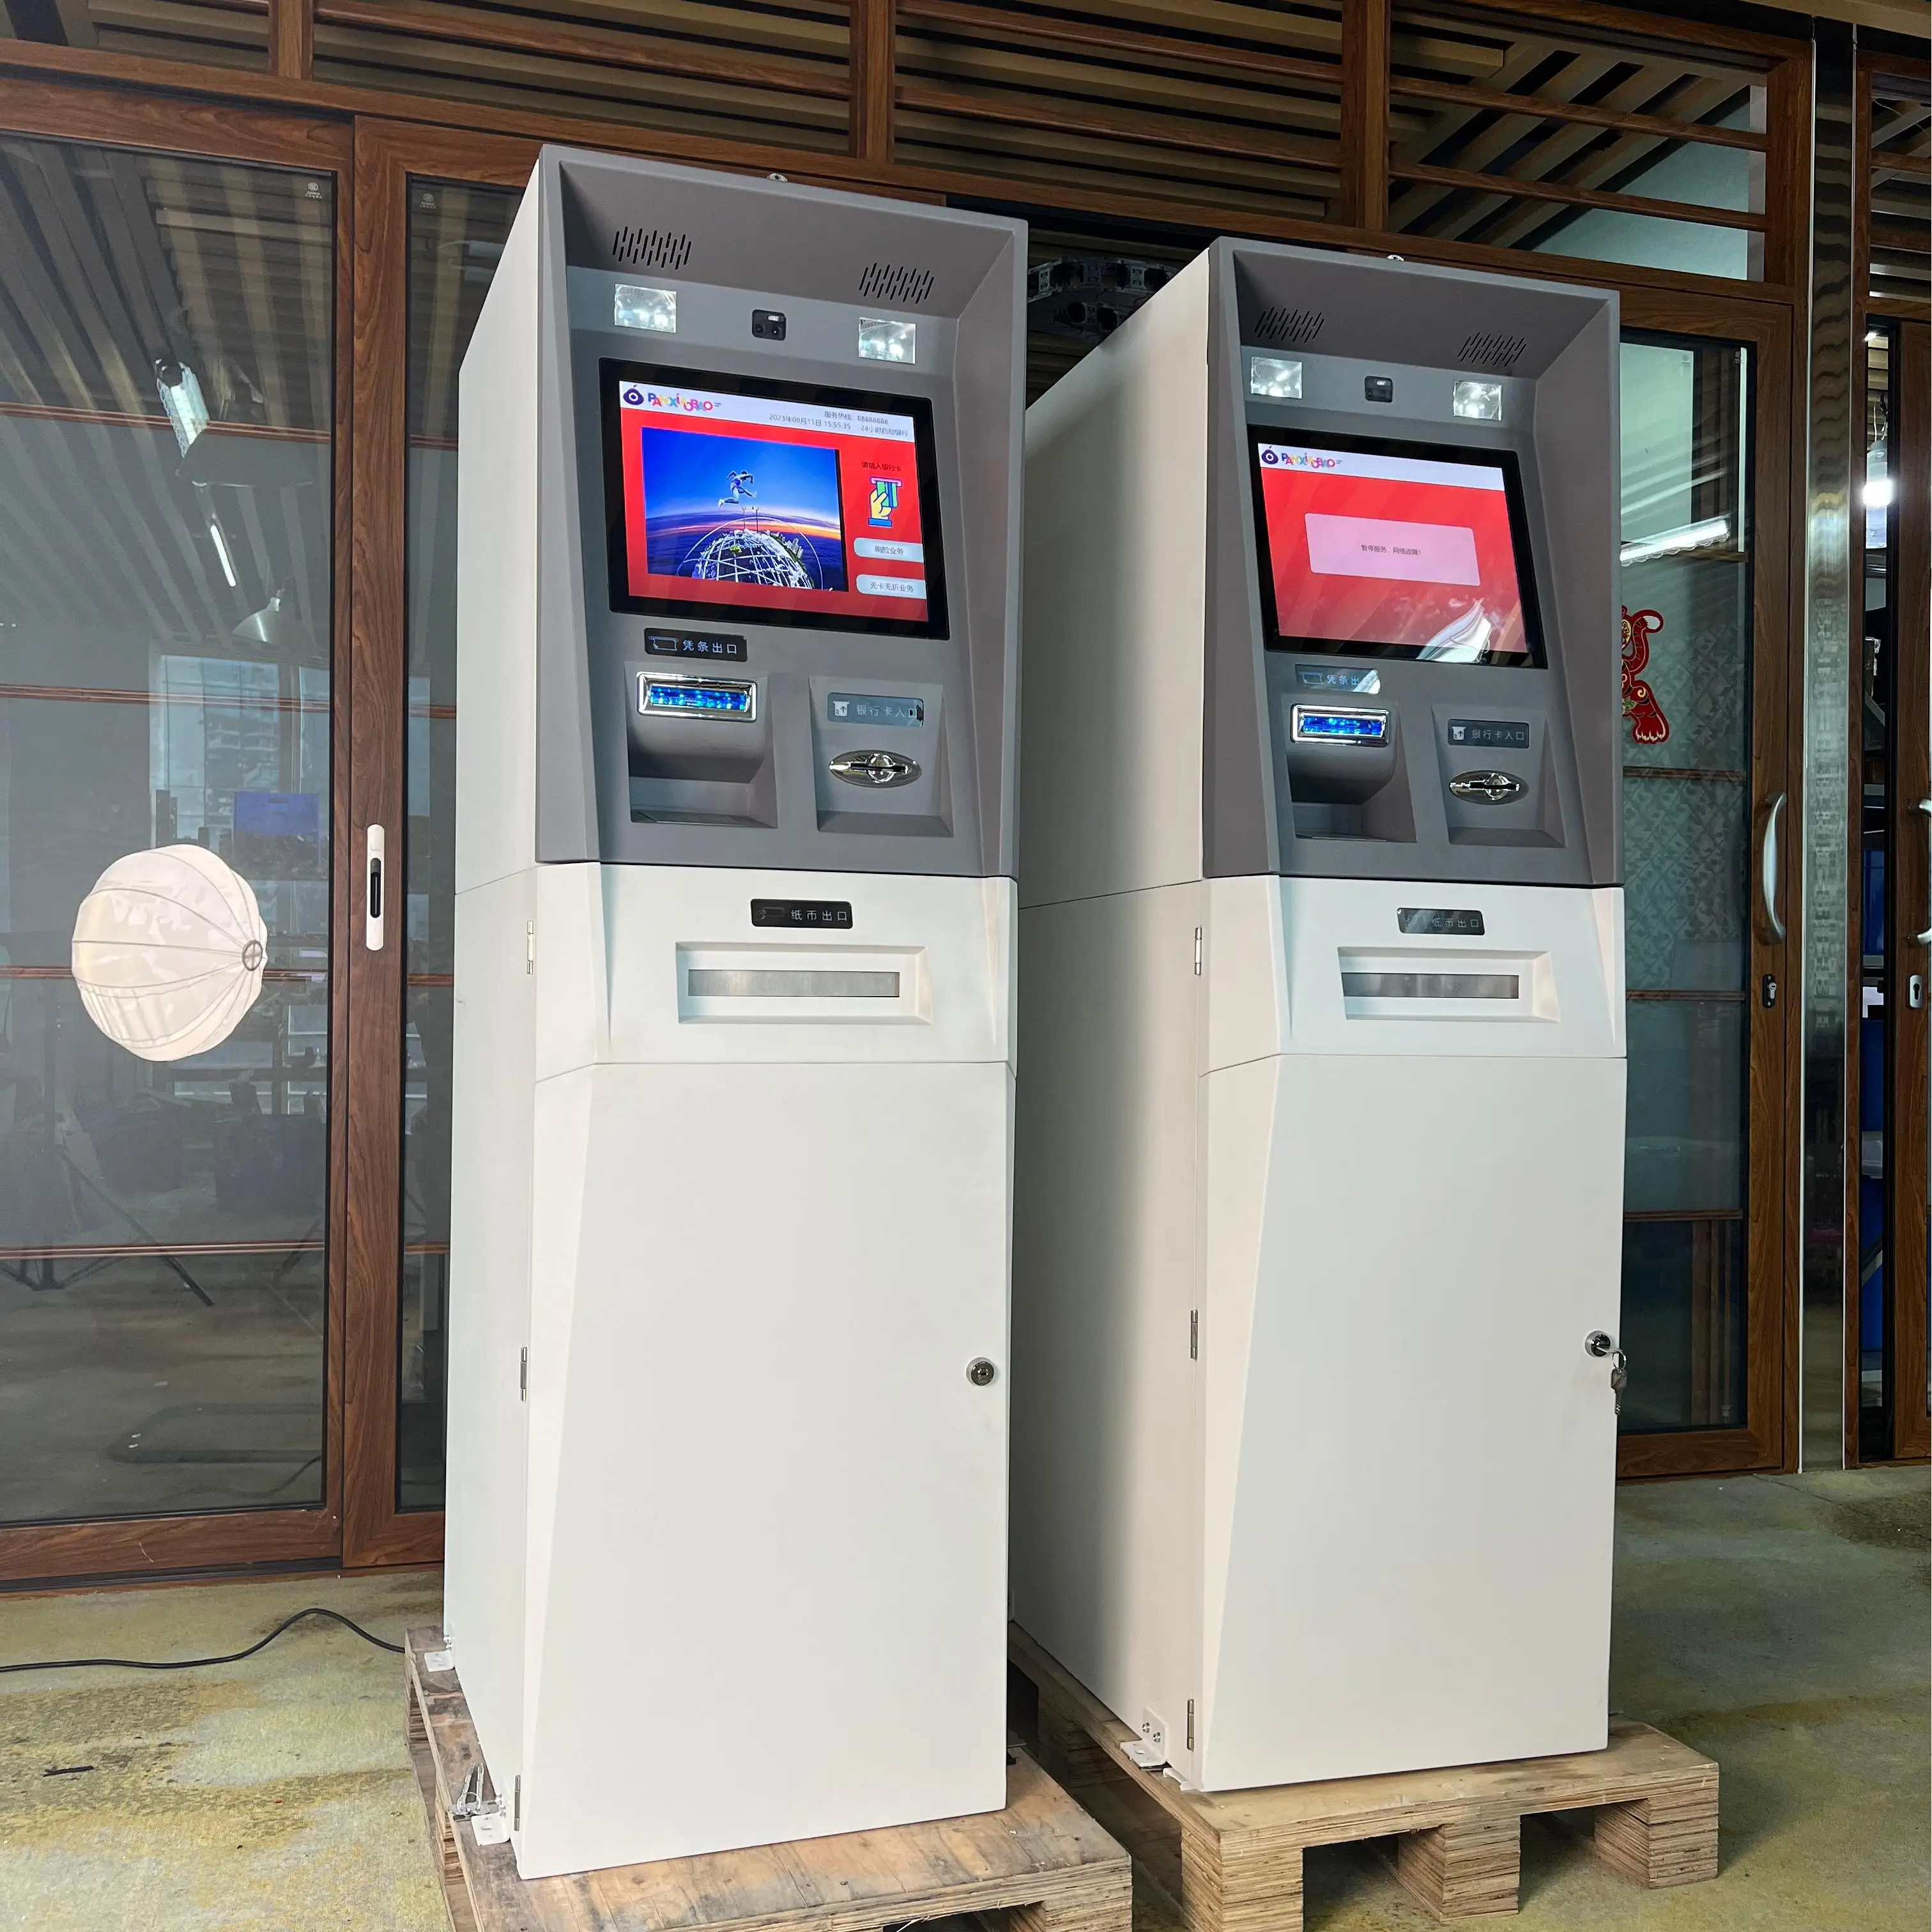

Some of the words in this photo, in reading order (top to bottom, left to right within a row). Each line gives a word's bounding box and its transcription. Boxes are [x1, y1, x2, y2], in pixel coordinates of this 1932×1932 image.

[870, 581, 914, 593] 无卡无折业务
[682, 640, 737, 655] 凭条出口
[857, 704, 917, 718] 银行卡入口
[1472, 728, 1524, 740] 银行卡入口
[790, 908, 847, 921] 纸币出口
